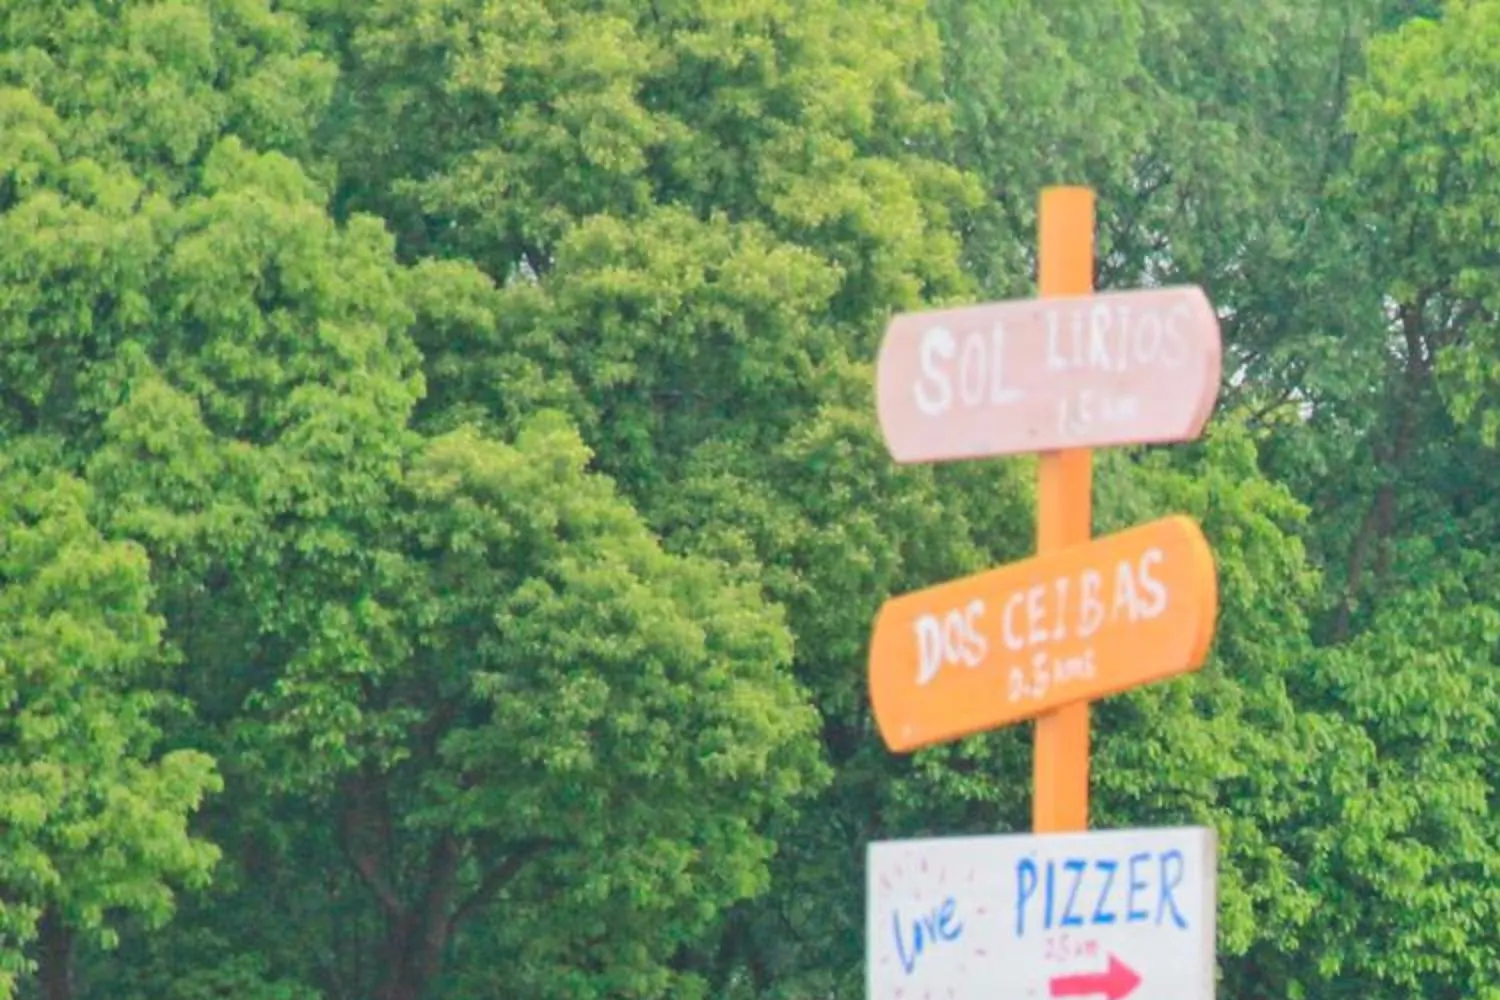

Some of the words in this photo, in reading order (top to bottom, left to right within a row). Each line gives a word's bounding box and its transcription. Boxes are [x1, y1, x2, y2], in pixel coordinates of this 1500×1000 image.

[912, 318, 1024, 417] SOL
[913, 599, 988, 686] DOS
[1001, 548, 1169, 651] CEIBAS
[1014, 849, 1190, 938] PIZZER
